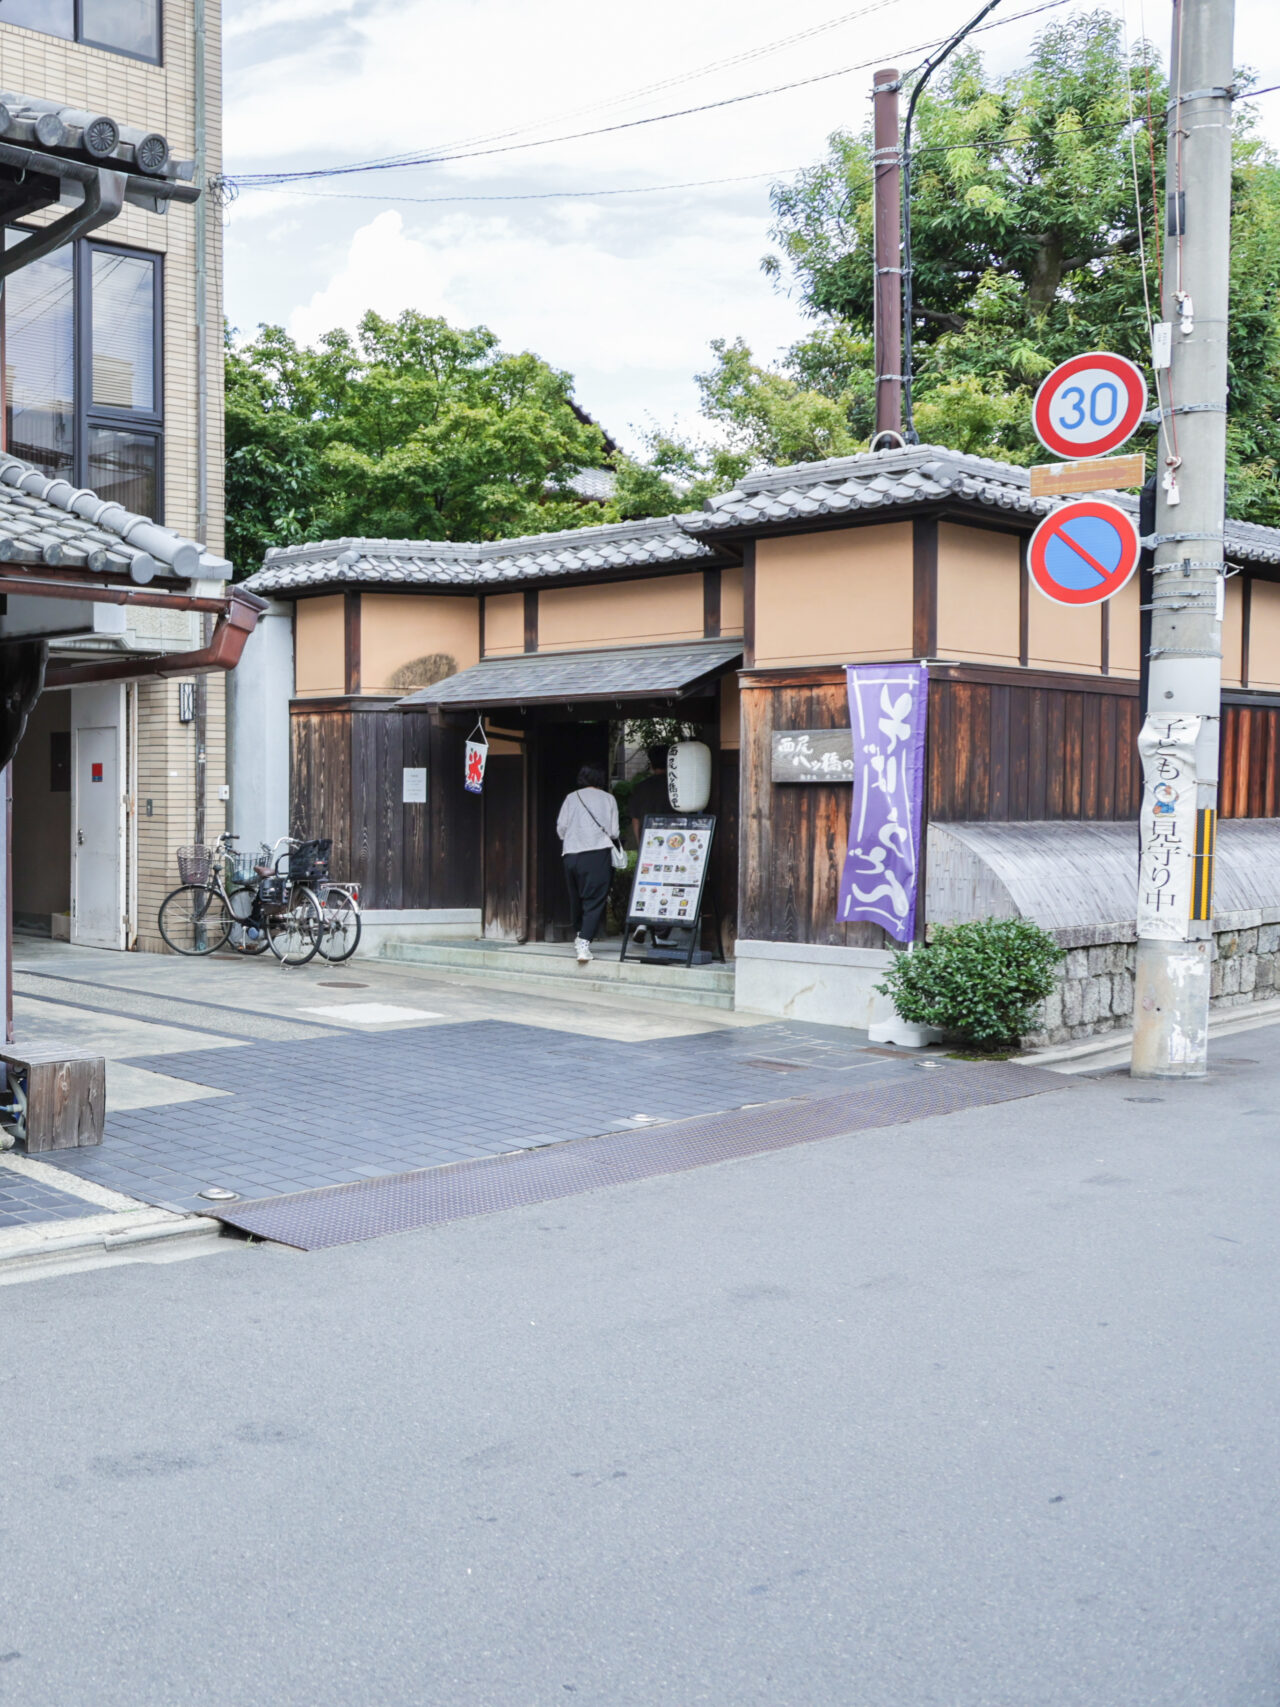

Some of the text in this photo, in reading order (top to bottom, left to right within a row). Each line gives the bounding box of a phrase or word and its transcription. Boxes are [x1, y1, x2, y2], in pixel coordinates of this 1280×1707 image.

[1059, 382, 1118, 430] 30
[467, 750, 482, 784] 氷
[778, 734, 813, 754] 西尾
[1153, 718, 1187, 780] 子ども
[1146, 821, 1182, 913] 見守り中
